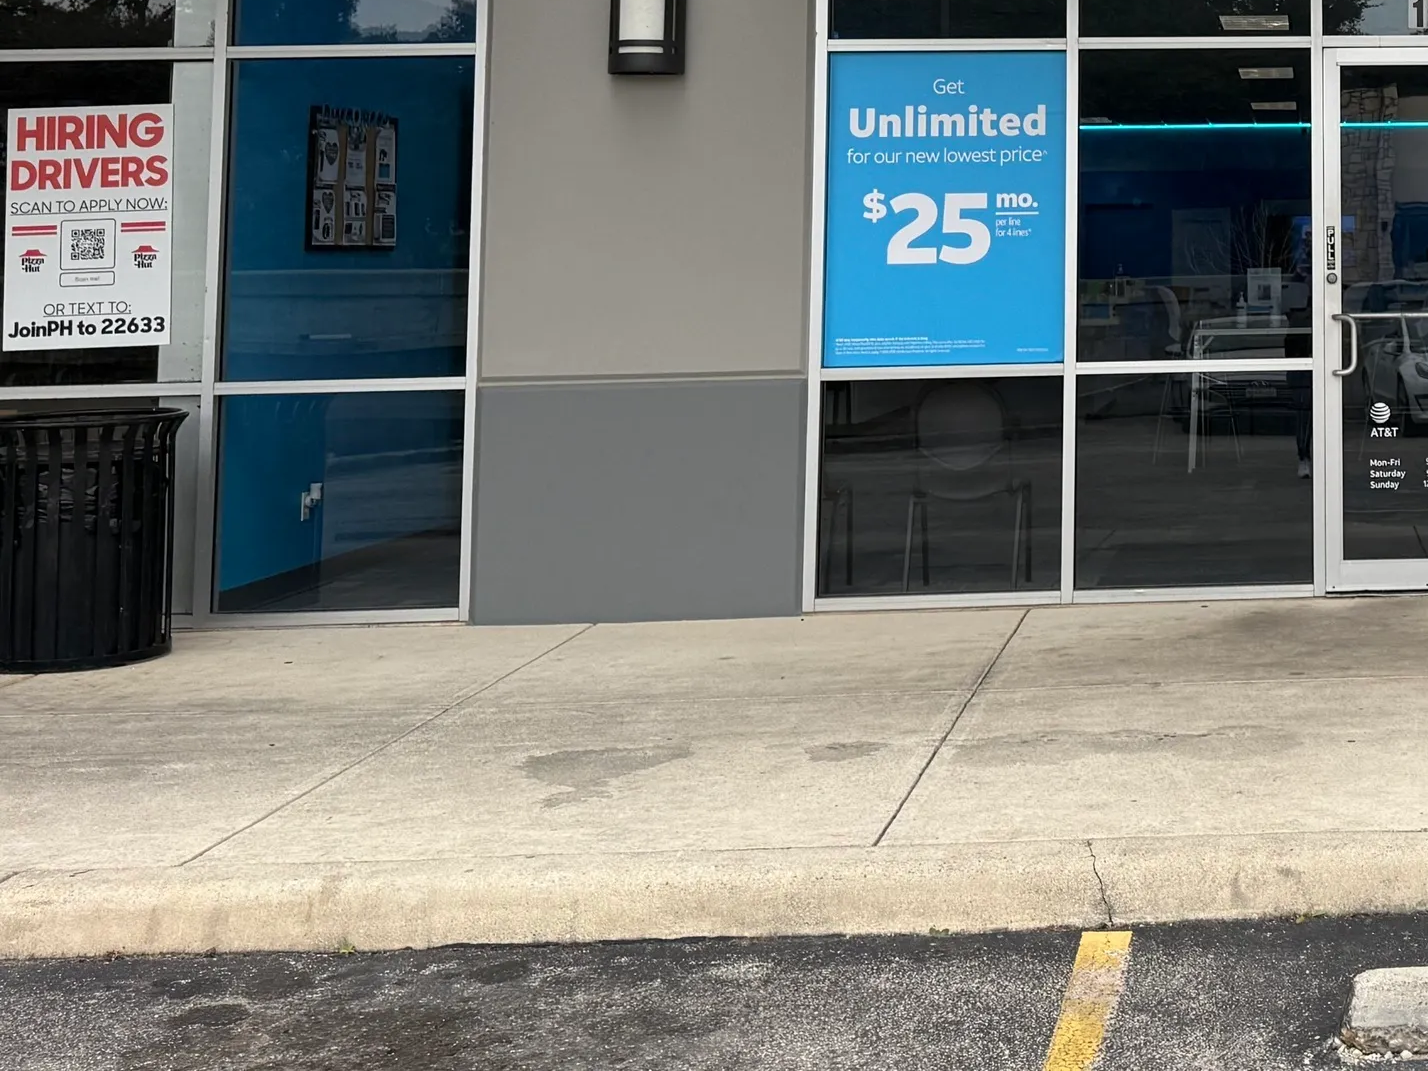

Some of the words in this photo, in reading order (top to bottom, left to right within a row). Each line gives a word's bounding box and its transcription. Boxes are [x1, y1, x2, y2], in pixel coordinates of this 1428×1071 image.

[932, 78, 965, 95] Get
[849, 104, 1047, 138] Unlimited
[16, 112, 165, 152] HIRING
[846, 148, 871, 164] for
[873, 151, 902, 164] our
[905, 151, 941, 164] new
[943, 147, 997, 163] lowest
[10, 154, 169, 191] DRIVERS
[10, 201, 52, 215] SCAN
[56, 200, 77, 213] TO
[79, 198, 123, 213] APPLY
[126, 197, 168, 211] NOW:
[862, 188, 991, 265] $25
[996, 192, 1039, 208] mo.
[995, 228, 1006, 237] for
[1327, 229, 1335, 260] PULL
[21, 257, 45, 266] Pizza
[133, 253, 157, 262] Pizza
[43, 303, 65, 316] OR
[69, 301, 104, 315] TEXT
[108, 300, 132, 314] TO:
[8, 320, 73, 339] JoinPH
[77, 320, 97, 335] to
[101, 316, 166, 335] 22633
[1370, 427, 1399, 438] AT&T
[1369, 458, 1401, 467] Mon-Fri
[1369, 469, 1406, 479] Saturday
[1369, 480, 1400, 490] Sunday
